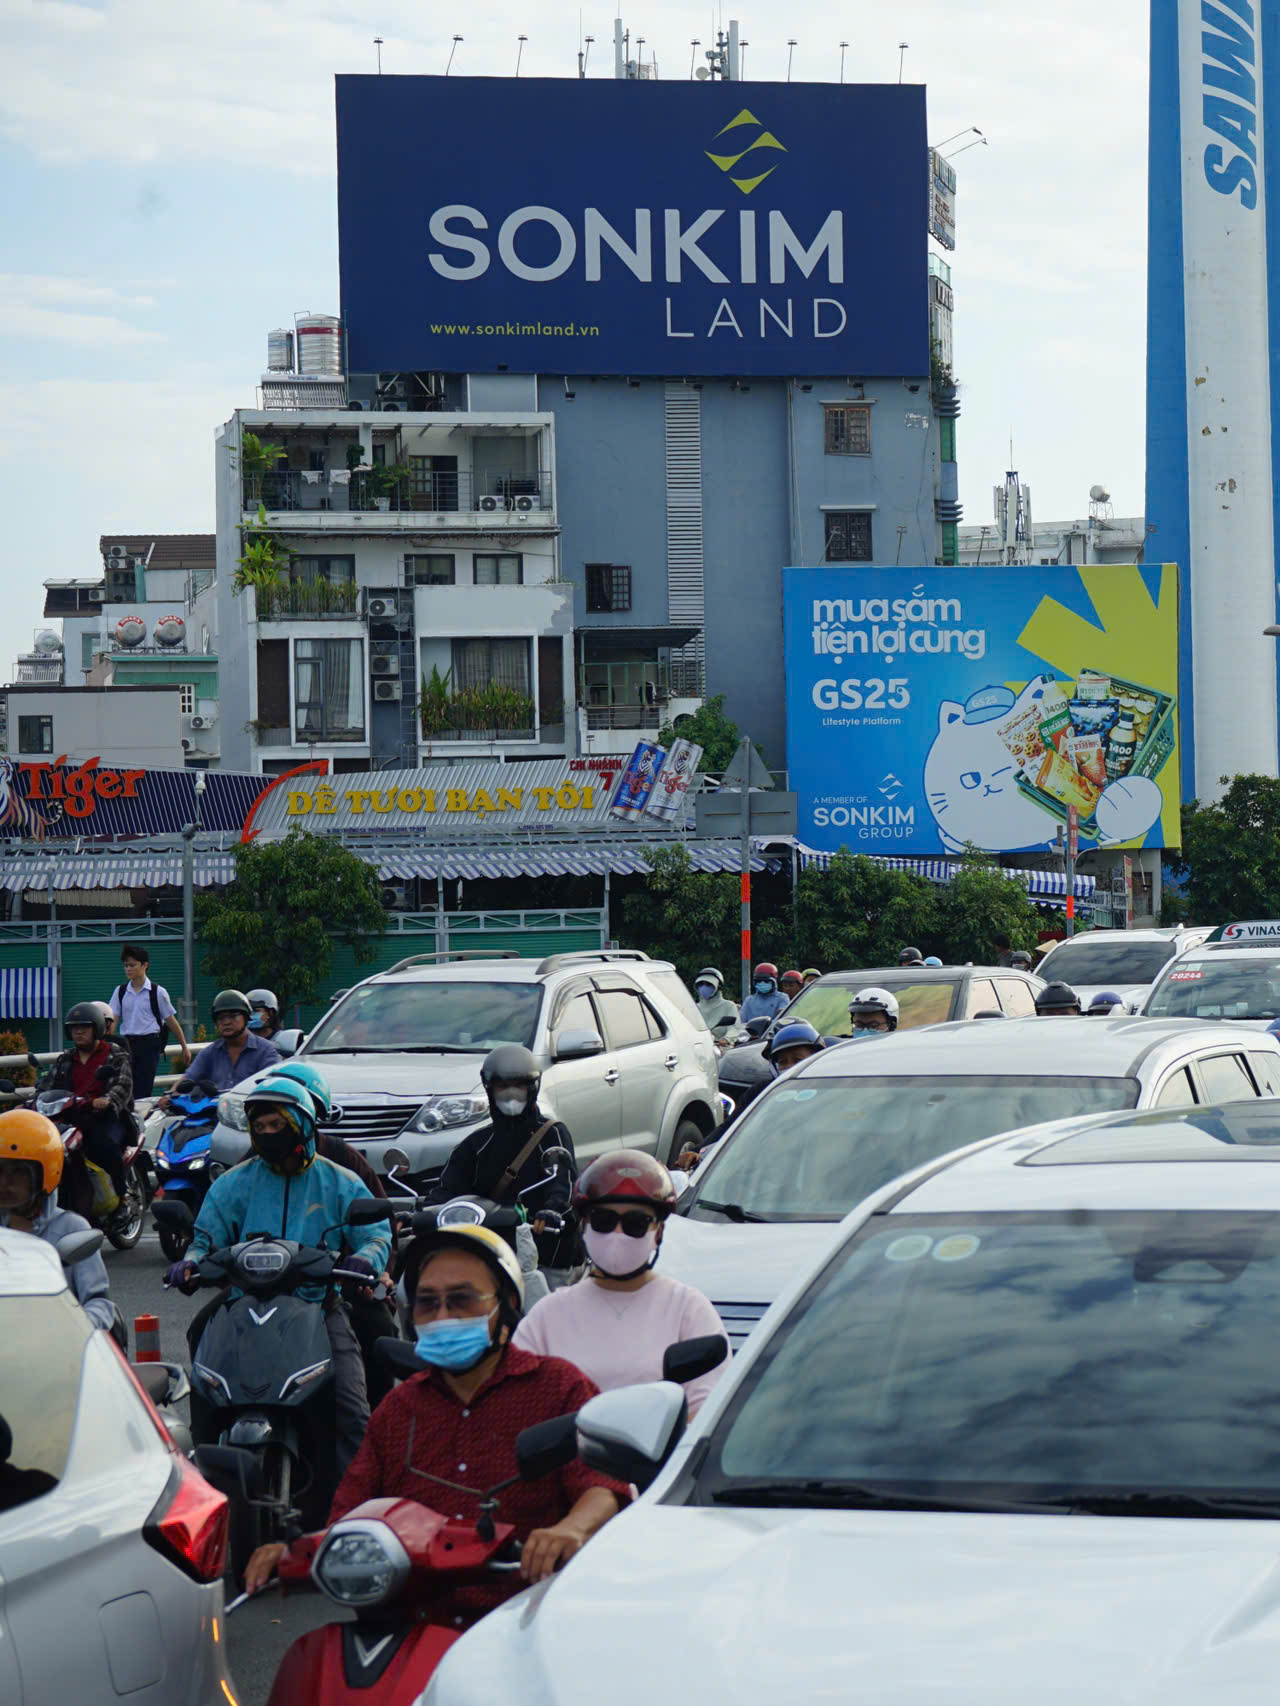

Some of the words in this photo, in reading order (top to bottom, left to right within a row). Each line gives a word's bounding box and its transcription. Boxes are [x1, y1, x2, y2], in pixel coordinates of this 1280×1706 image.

[428, 204, 844, 284] SONKIM
[666, 297, 848, 338] LAND
[430, 322, 600, 337] www.sonkimland.vn
[813, 599, 888, 622] mua
[891, 583, 961, 622] sắm
[812, 621, 868, 664] tiện
[872, 621, 906, 664] lợi
[909, 621, 985, 660] cùng
[812, 678, 910, 710] GS25
[1045, 701, 1067, 714] 1400
[822, 717, 860, 727] Lifestyle
[863, 717, 901, 726] Platform
[1109, 742, 1132, 755] 1400
[570, 760, 586, 770] CHI
[588, 757, 622, 770] NHÁNH
[18, 754, 146, 818] Tiger
[599, 771, 614, 791] 7
[623, 770, 653, 794] Tiger
[658, 769, 689, 793] Tiger
[287, 784, 337, 815] DÊ
[344, 786, 436, 814] TƯƠI
[445, 787, 523, 820] BẠN
[532, 779, 595, 810] TÔI
[813, 806, 914, 827] SONKIM
[858, 827, 914, 839] GROUP
[1171, 972, 1201, 980] 20244
